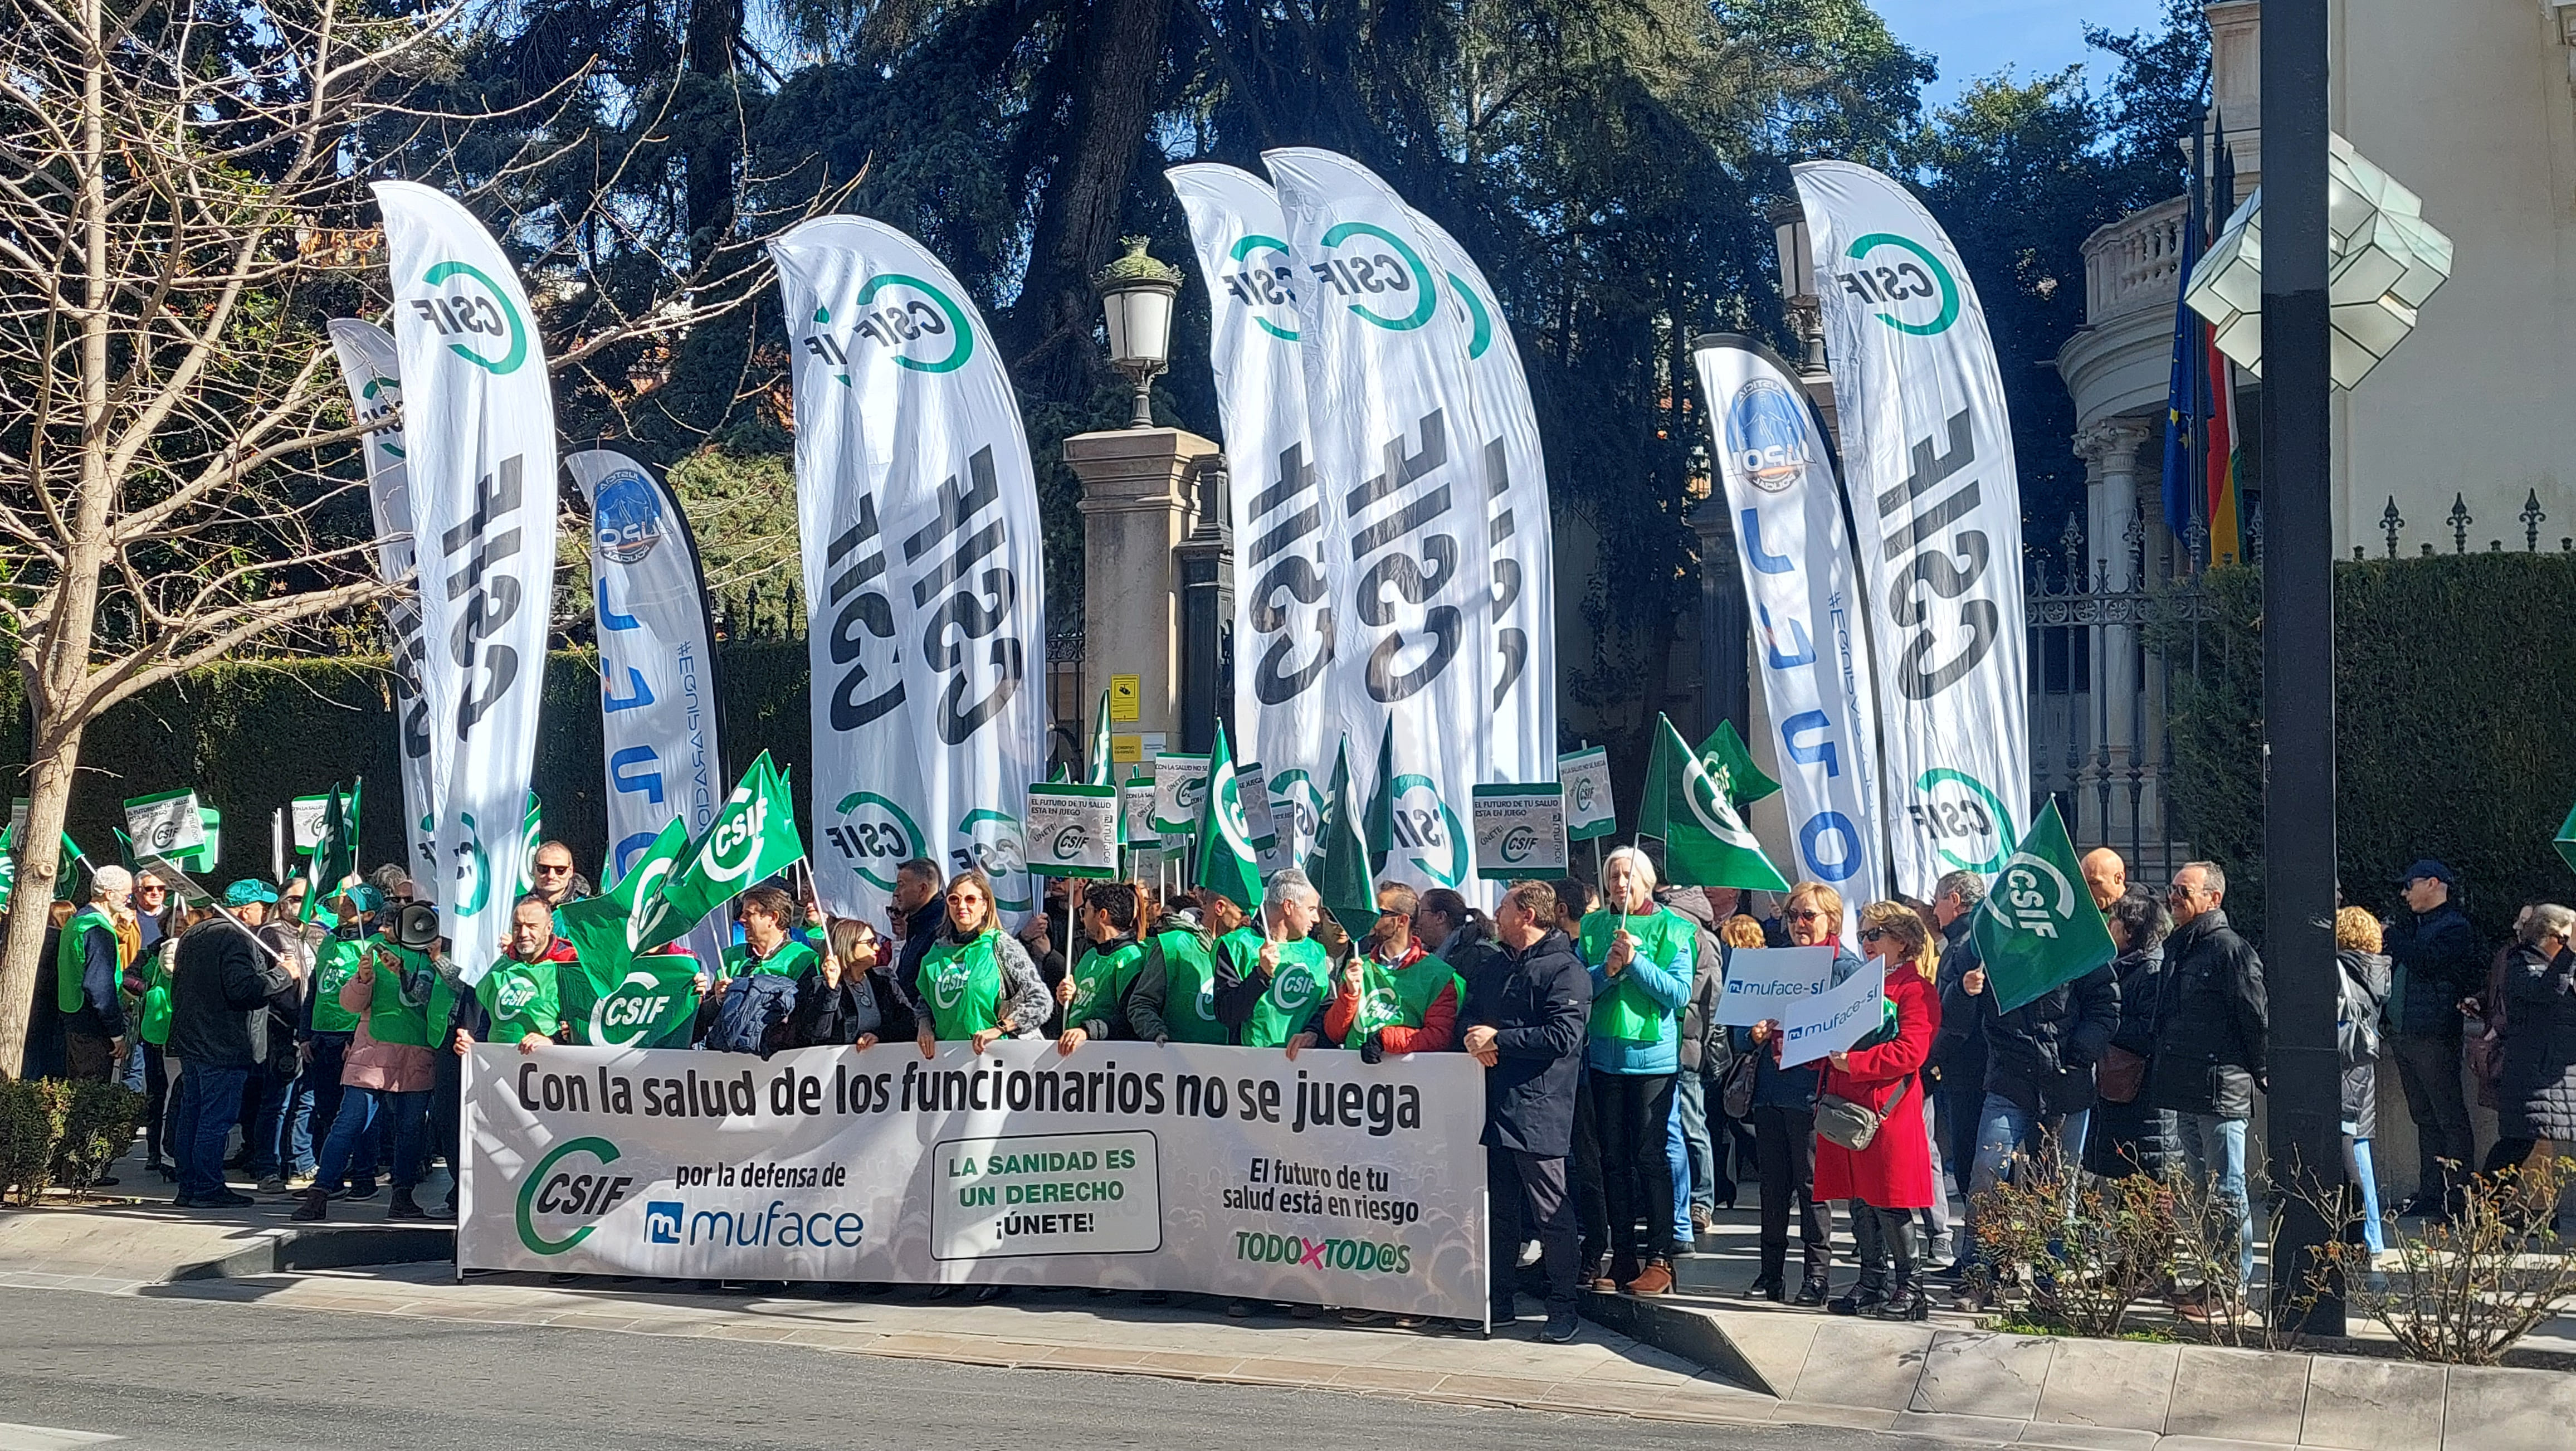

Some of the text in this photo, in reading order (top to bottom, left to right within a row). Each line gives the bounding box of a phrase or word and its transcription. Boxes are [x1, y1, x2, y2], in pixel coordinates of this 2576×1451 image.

[157, 826, 179, 840] CSIF
[716, 796, 768, 858] CSIF
[1060, 835, 1089, 849] CSIF
[1103, 825, 1113, 863] muface
[1508, 837, 1539, 851] CSIF
[1553, 823, 1563, 864] muface
[2007, 869, 2059, 939] CSIF
[1284, 976, 1316, 994] CSIF
[605, 996, 670, 1026] CSIF
[518, 1060, 1421, 1137] Con la salud de los funcionarios no se juega
[675, 1161, 846, 1190] por la defensa de
[949, 1149, 1135, 1178] LA SANIDAD ES
[1250, 1157, 1388, 1192] El futuro de tu
[536, 1174, 633, 1216] CSIF
[960, 1180, 1124, 1207] UN DERECHO
[1223, 1185, 1419, 1225] salud está en riesgo
[689, 1200, 864, 1248] muface
[996, 1211, 1094, 1240] ¡ÚNETE!
